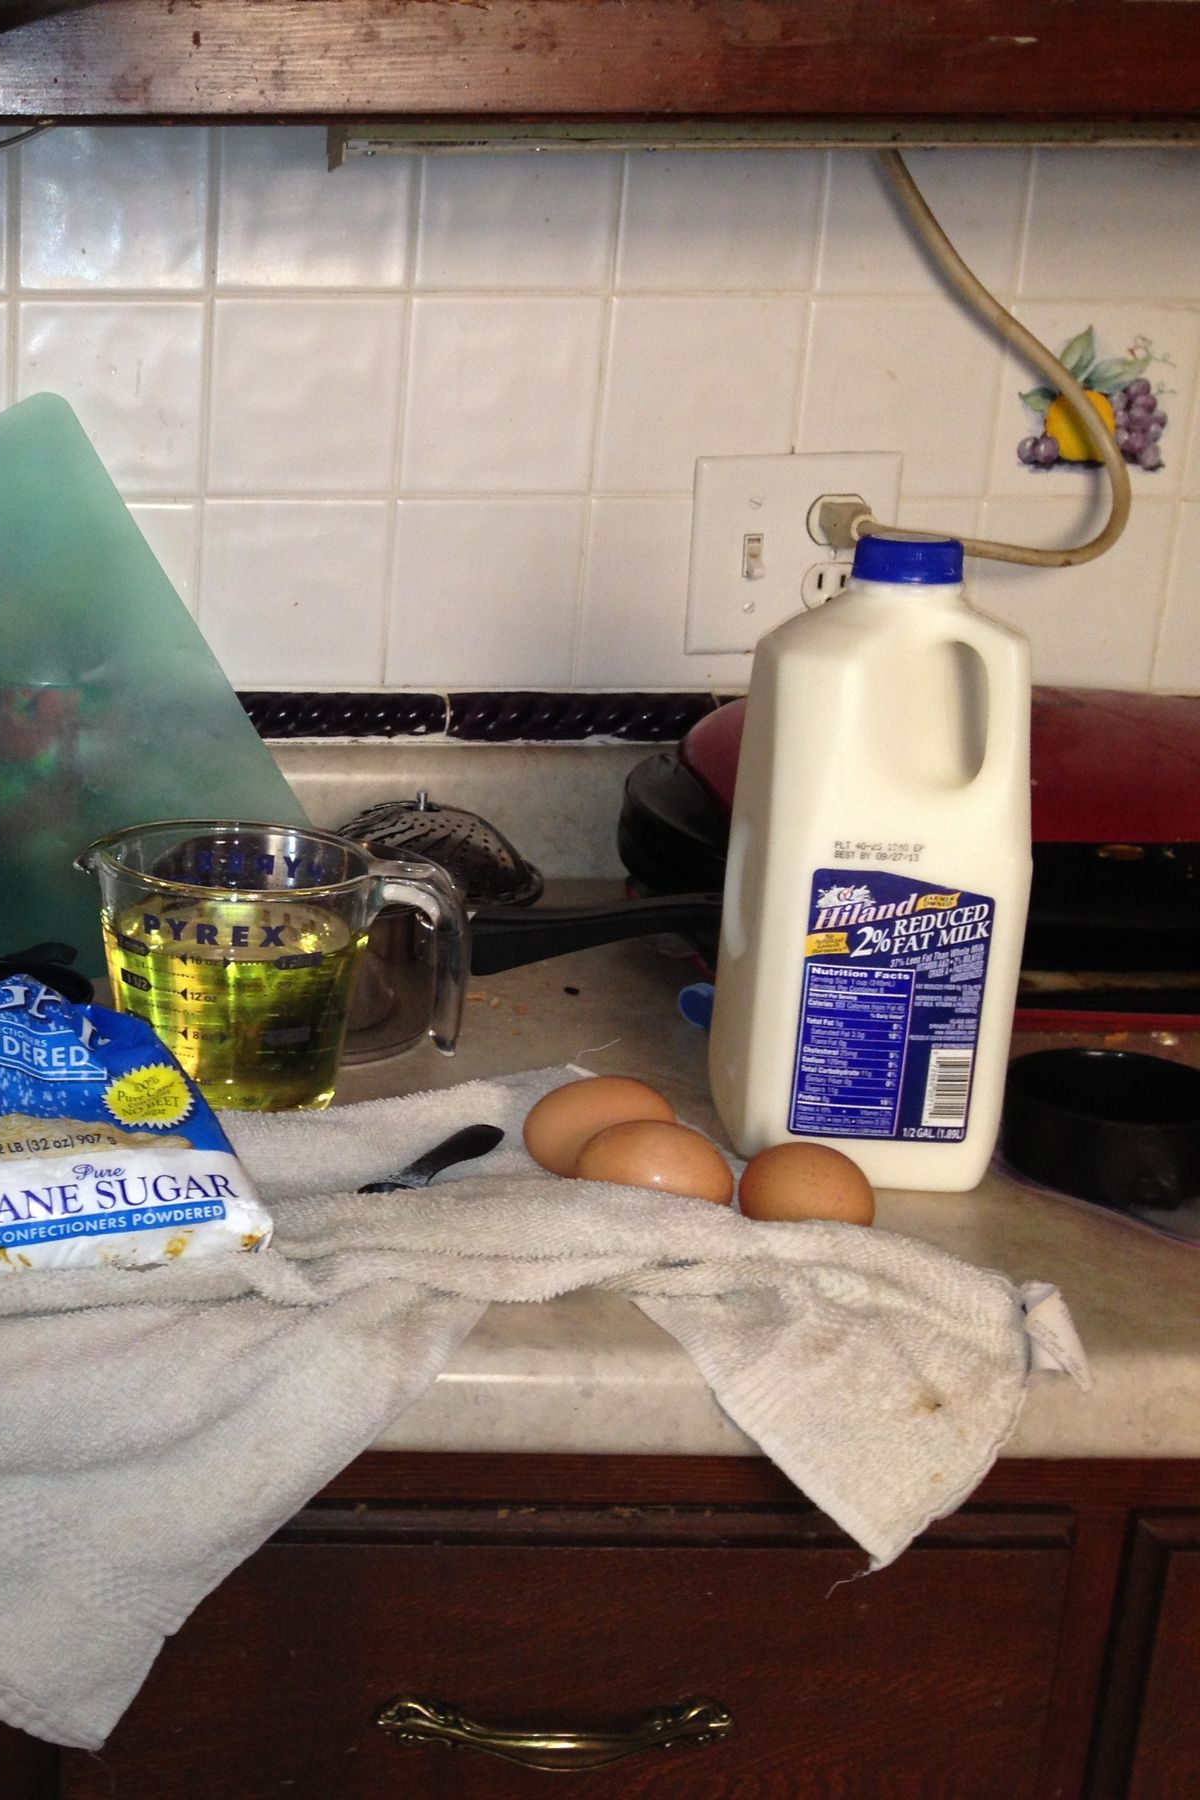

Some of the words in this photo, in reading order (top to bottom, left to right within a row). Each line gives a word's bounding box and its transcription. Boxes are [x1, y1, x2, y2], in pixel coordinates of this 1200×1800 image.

[834, 850, 856, 860] BEST
[860, 852, 872, 860] BY
[876, 852, 920, 862] 09/27/13
[811, 893, 919, 931] Hiland
[893, 903, 990, 938] REDUCED
[143, 913, 286, 948] PYREX
[850, 926, 892, 958] 2%
[891, 931, 935, 956] FAT
[936, 920, 992, 948] MILK
[811, 966, 868, 978] Nutrition
[874, 971, 911, 980] Facts
[190, 991, 202, 1002] 12
[204, 994, 218, 1003] oz
[192, 1031, 200, 1040] 8
[117, 1090, 145, 1103] Pure
[903, 1127, 917, 1138] 1/2
[7, 1140, 24, 1153] LB
[26, 1136, 50, 1153] (32
[54, 1133, 76, 1151] oz)
[77, 1133, 102, 1146] 907
[72, 1164, 126, 1181] Pure
[97, 1173, 240, 1211] SUGAR
[132, 1204, 224, 1227] POWDERED
